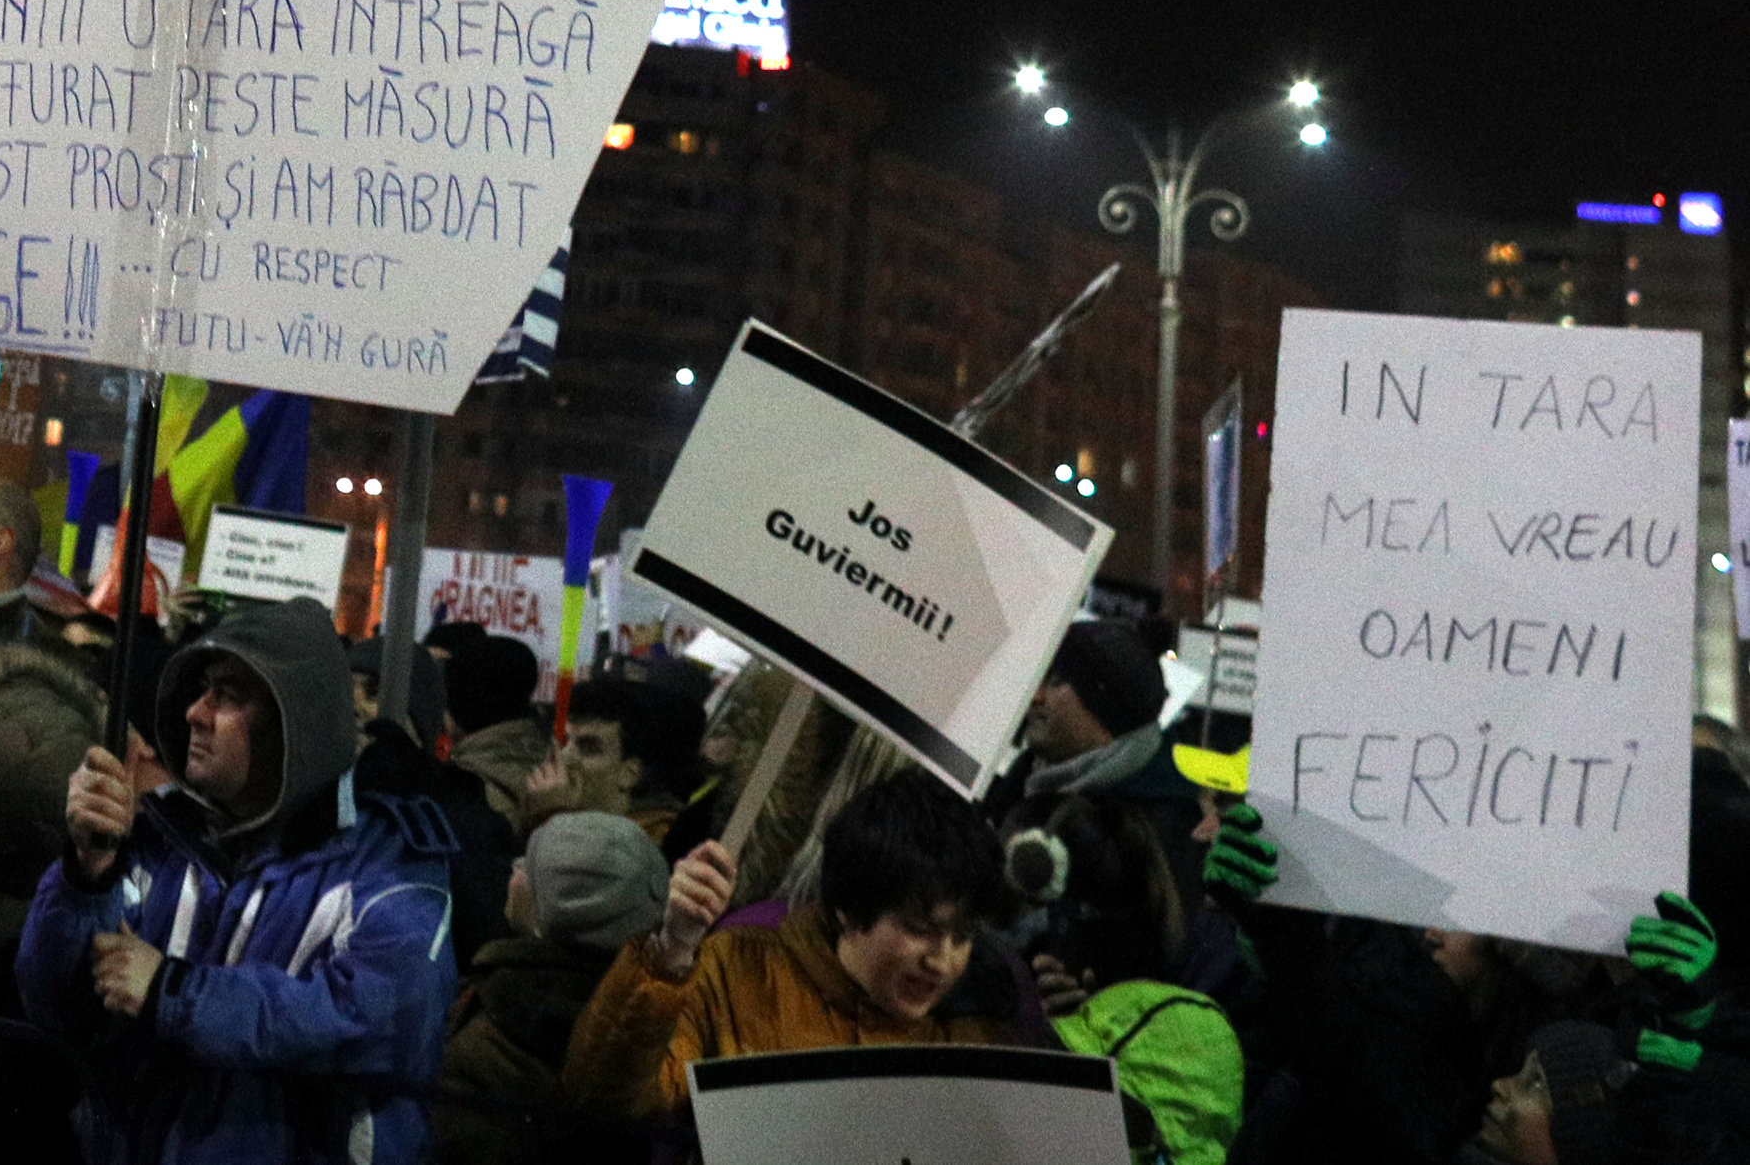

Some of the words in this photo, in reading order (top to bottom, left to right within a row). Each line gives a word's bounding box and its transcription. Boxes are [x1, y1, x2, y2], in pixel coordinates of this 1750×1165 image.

[176, 64, 320, 136] PESTE
[273, 157, 334, 227] AM
[170, 238, 221, 282] CU
[254, 240, 402, 291] RESPECT
[1340, 361, 1427, 425] IN
[1478, 371, 1659, 442] TARA
[847, 499, 913, 552] Jos
[1320, 491, 1450, 555] MEA
[1487, 511, 1680, 569] VREAU
[1360, 609, 1626, 682] OAMENI
[1292, 721, 1641, 833] FERICITI
